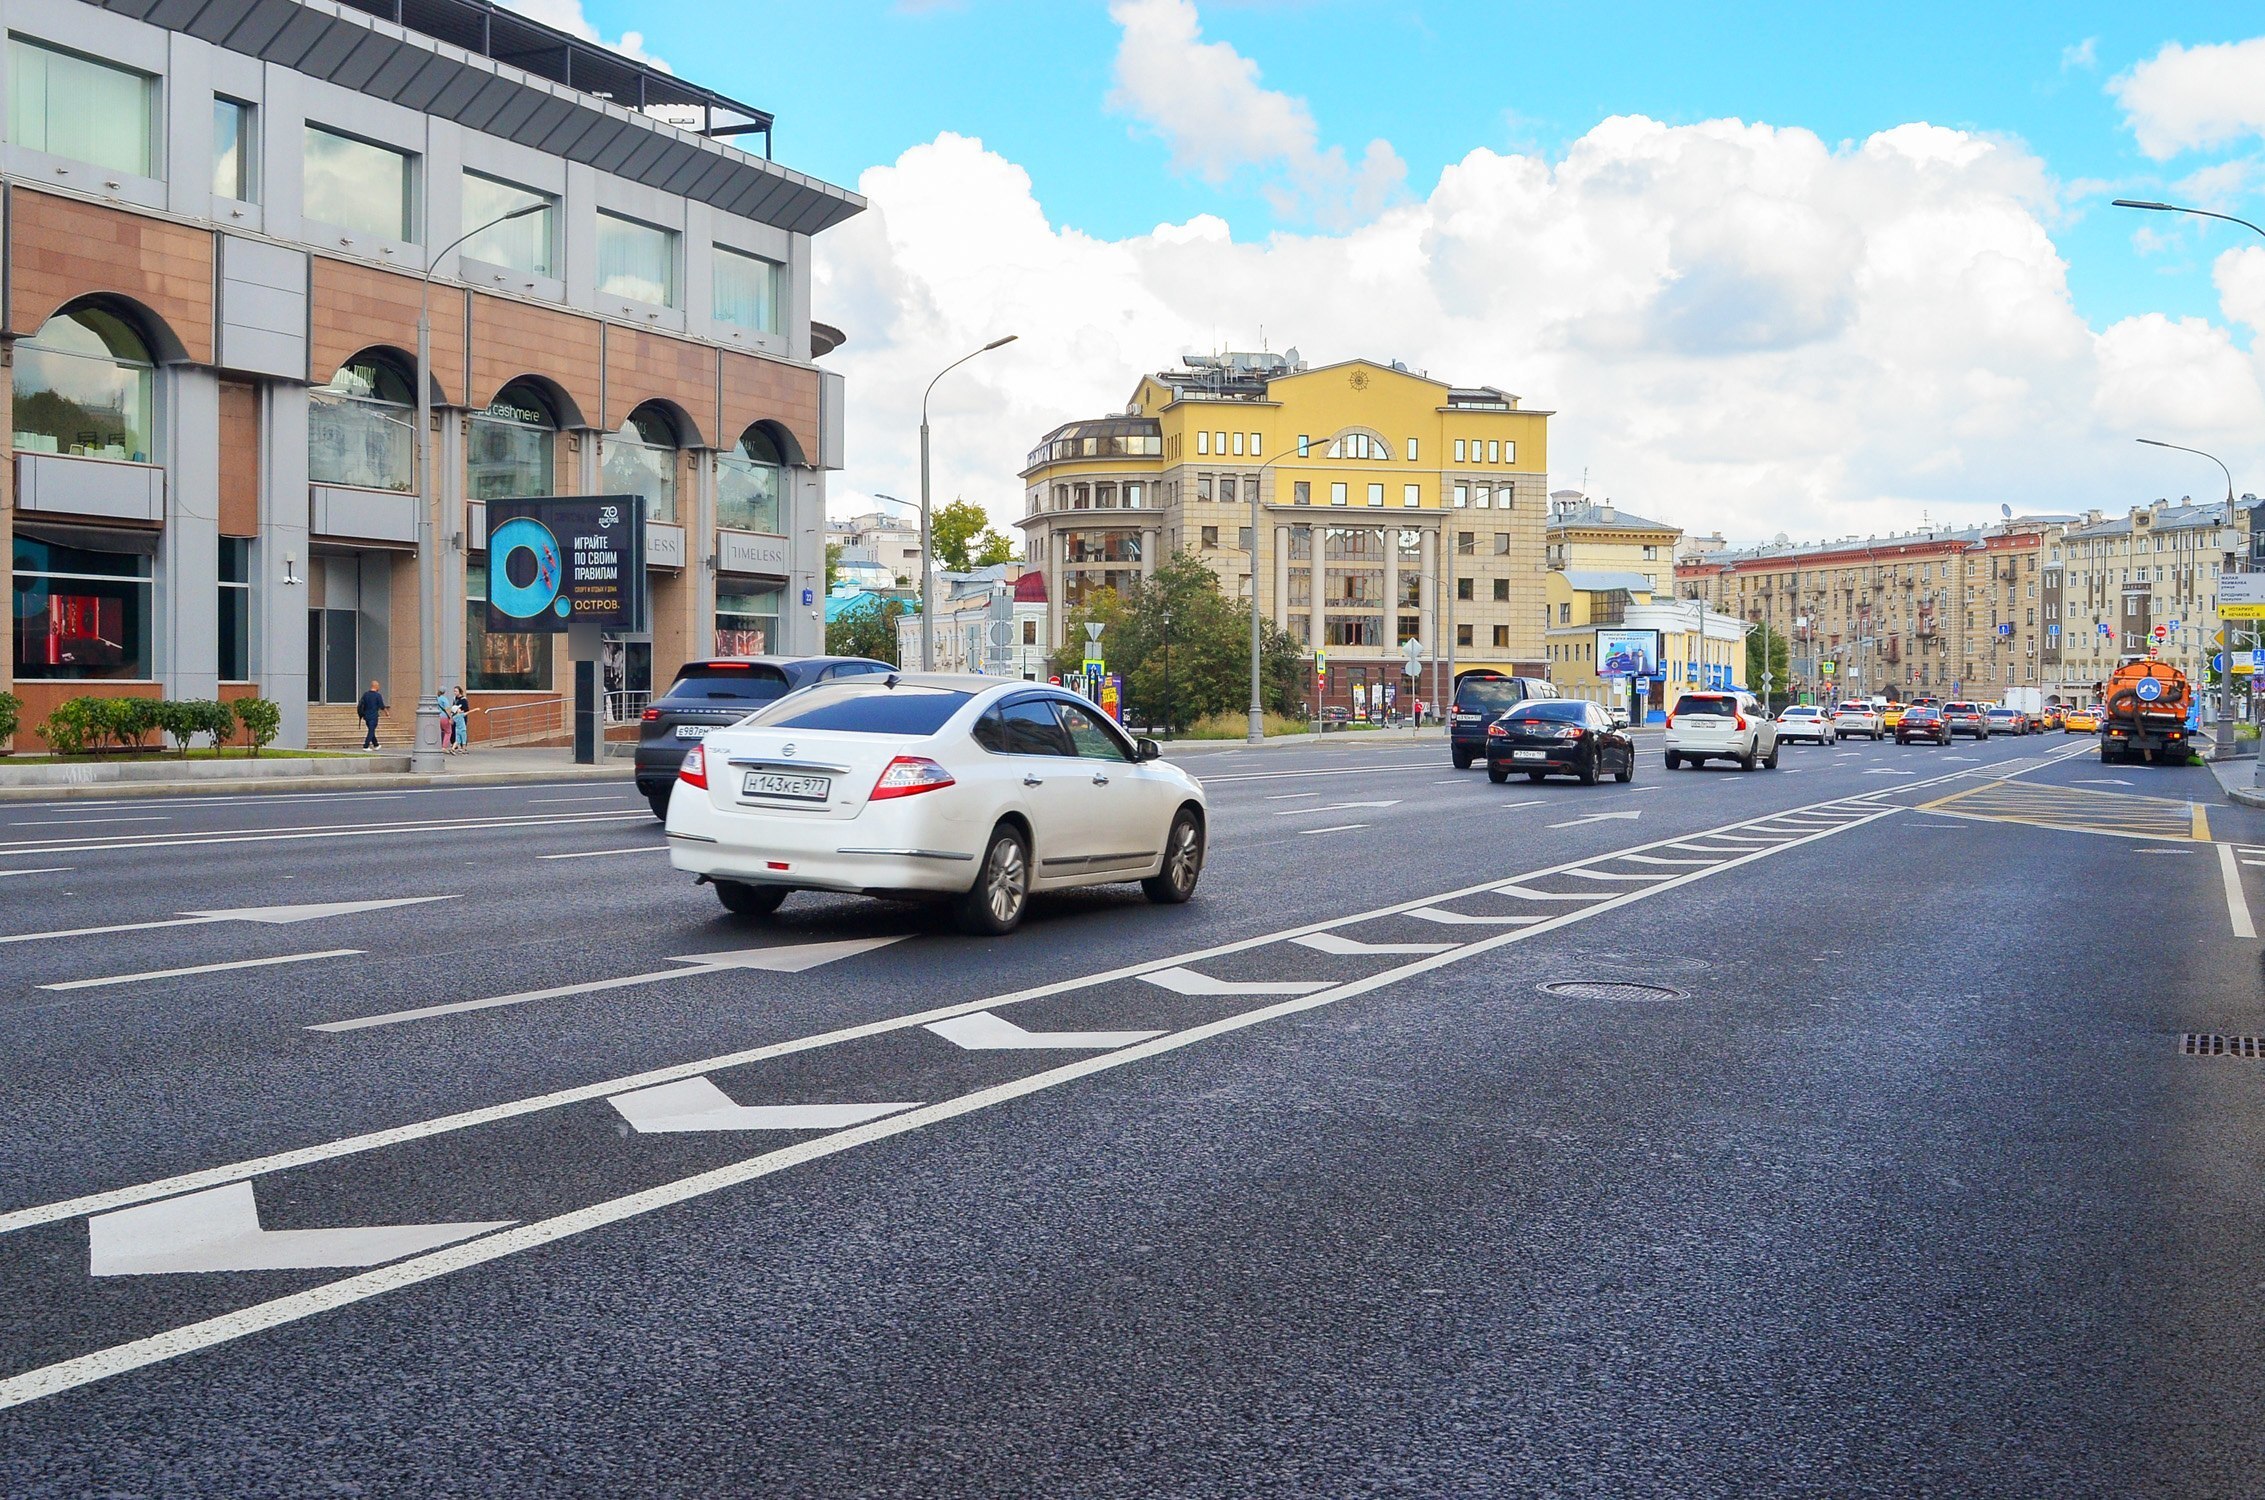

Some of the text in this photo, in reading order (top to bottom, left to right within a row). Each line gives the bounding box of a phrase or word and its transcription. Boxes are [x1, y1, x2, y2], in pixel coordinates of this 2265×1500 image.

[492, 404, 540, 422] cashmere
[574, 534, 608, 550] ИГРАЙТЕ
[574, 551, 618, 565] ПО СВОИМ
[731, 546, 782, 562] TIMELESS
[574, 567, 618, 580] ПРАВИЛАМ
